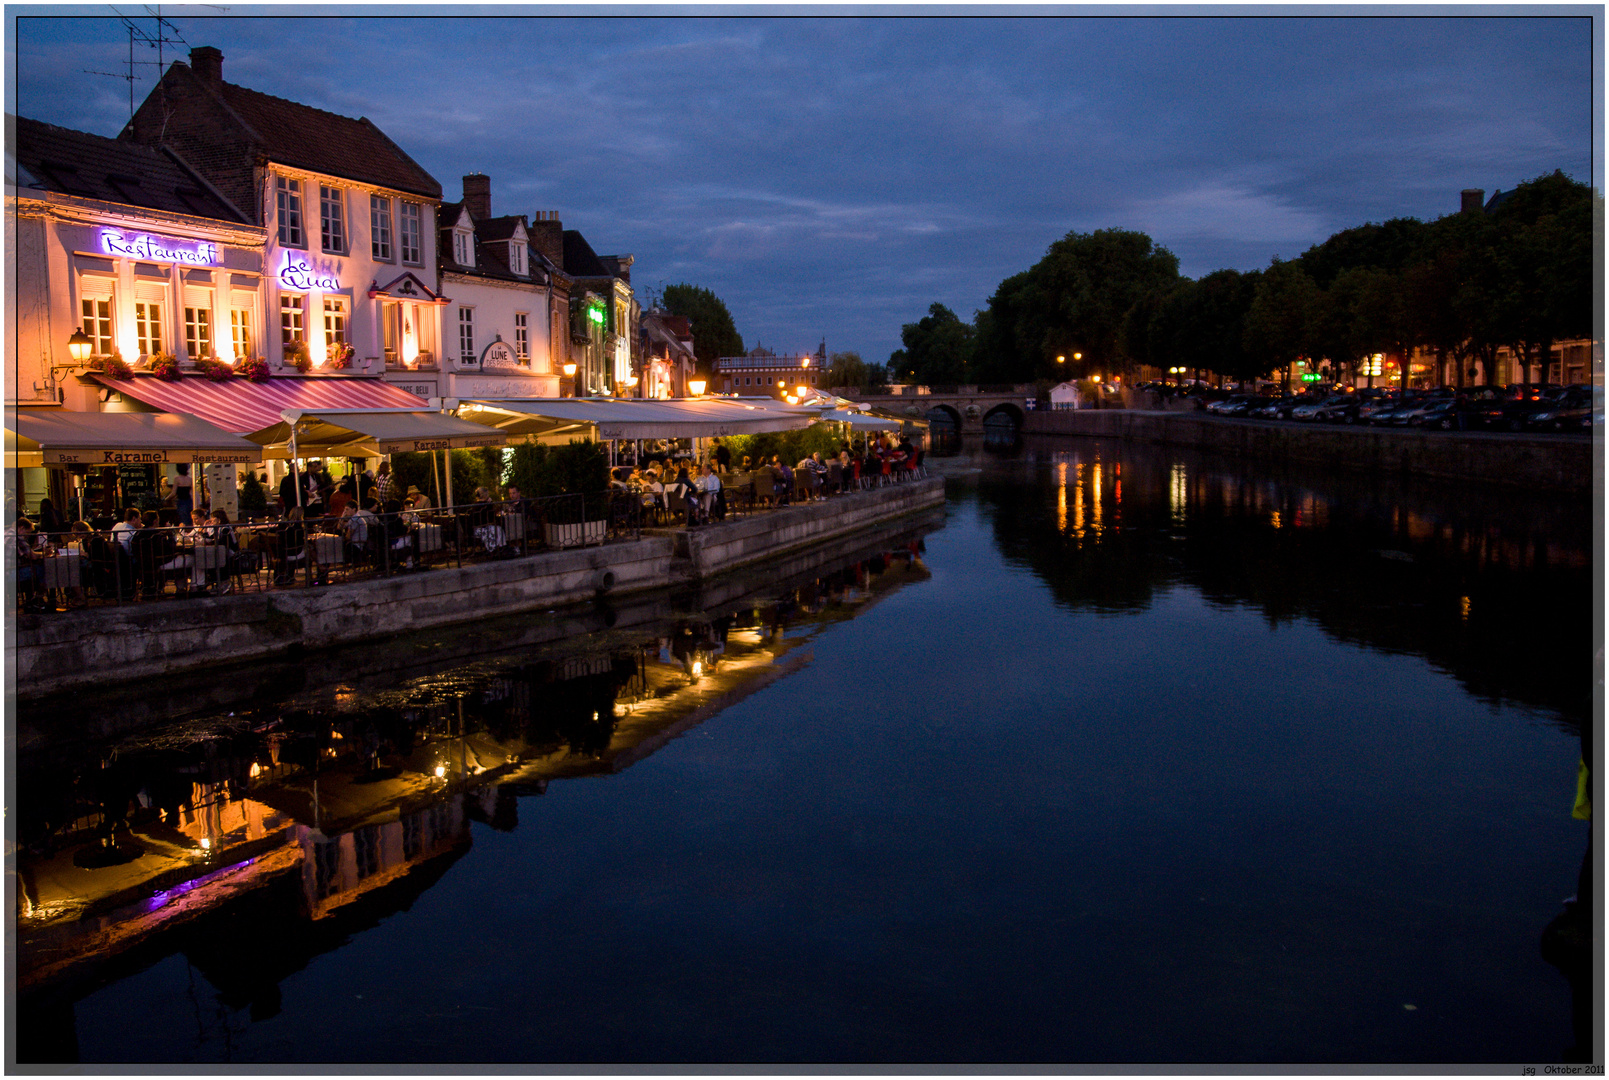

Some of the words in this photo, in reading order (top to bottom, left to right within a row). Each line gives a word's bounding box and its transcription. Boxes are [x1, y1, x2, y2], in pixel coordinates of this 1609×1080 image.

[101, 232, 219, 264] Restaurant
[287, 250, 313, 273] Le
[280, 267, 340, 290] Quai
[491, 350, 508, 360] LUNE
[413, 439, 452, 451] Karamel
[59, 454, 79, 463] Bar
[103, 450, 170, 463] Karamel
[192, 454, 251, 463] Restaurant
